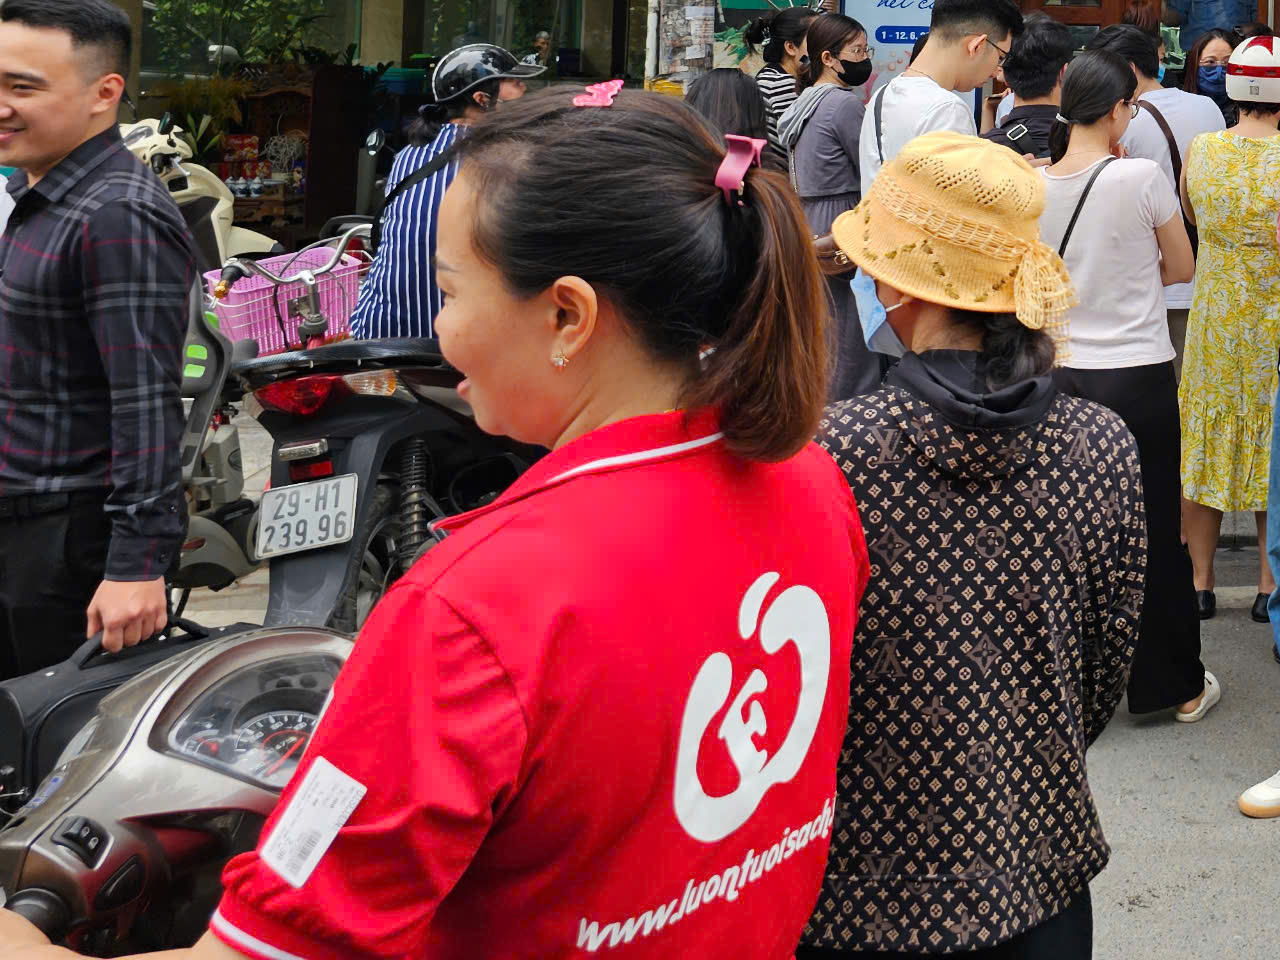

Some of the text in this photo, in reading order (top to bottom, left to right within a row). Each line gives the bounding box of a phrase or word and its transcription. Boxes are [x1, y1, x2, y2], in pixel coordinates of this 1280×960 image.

[273, 481, 342, 521] 29-H1
[262, 511, 347, 554] 239.96
[576, 790, 837, 952] www.luontuoisach.
